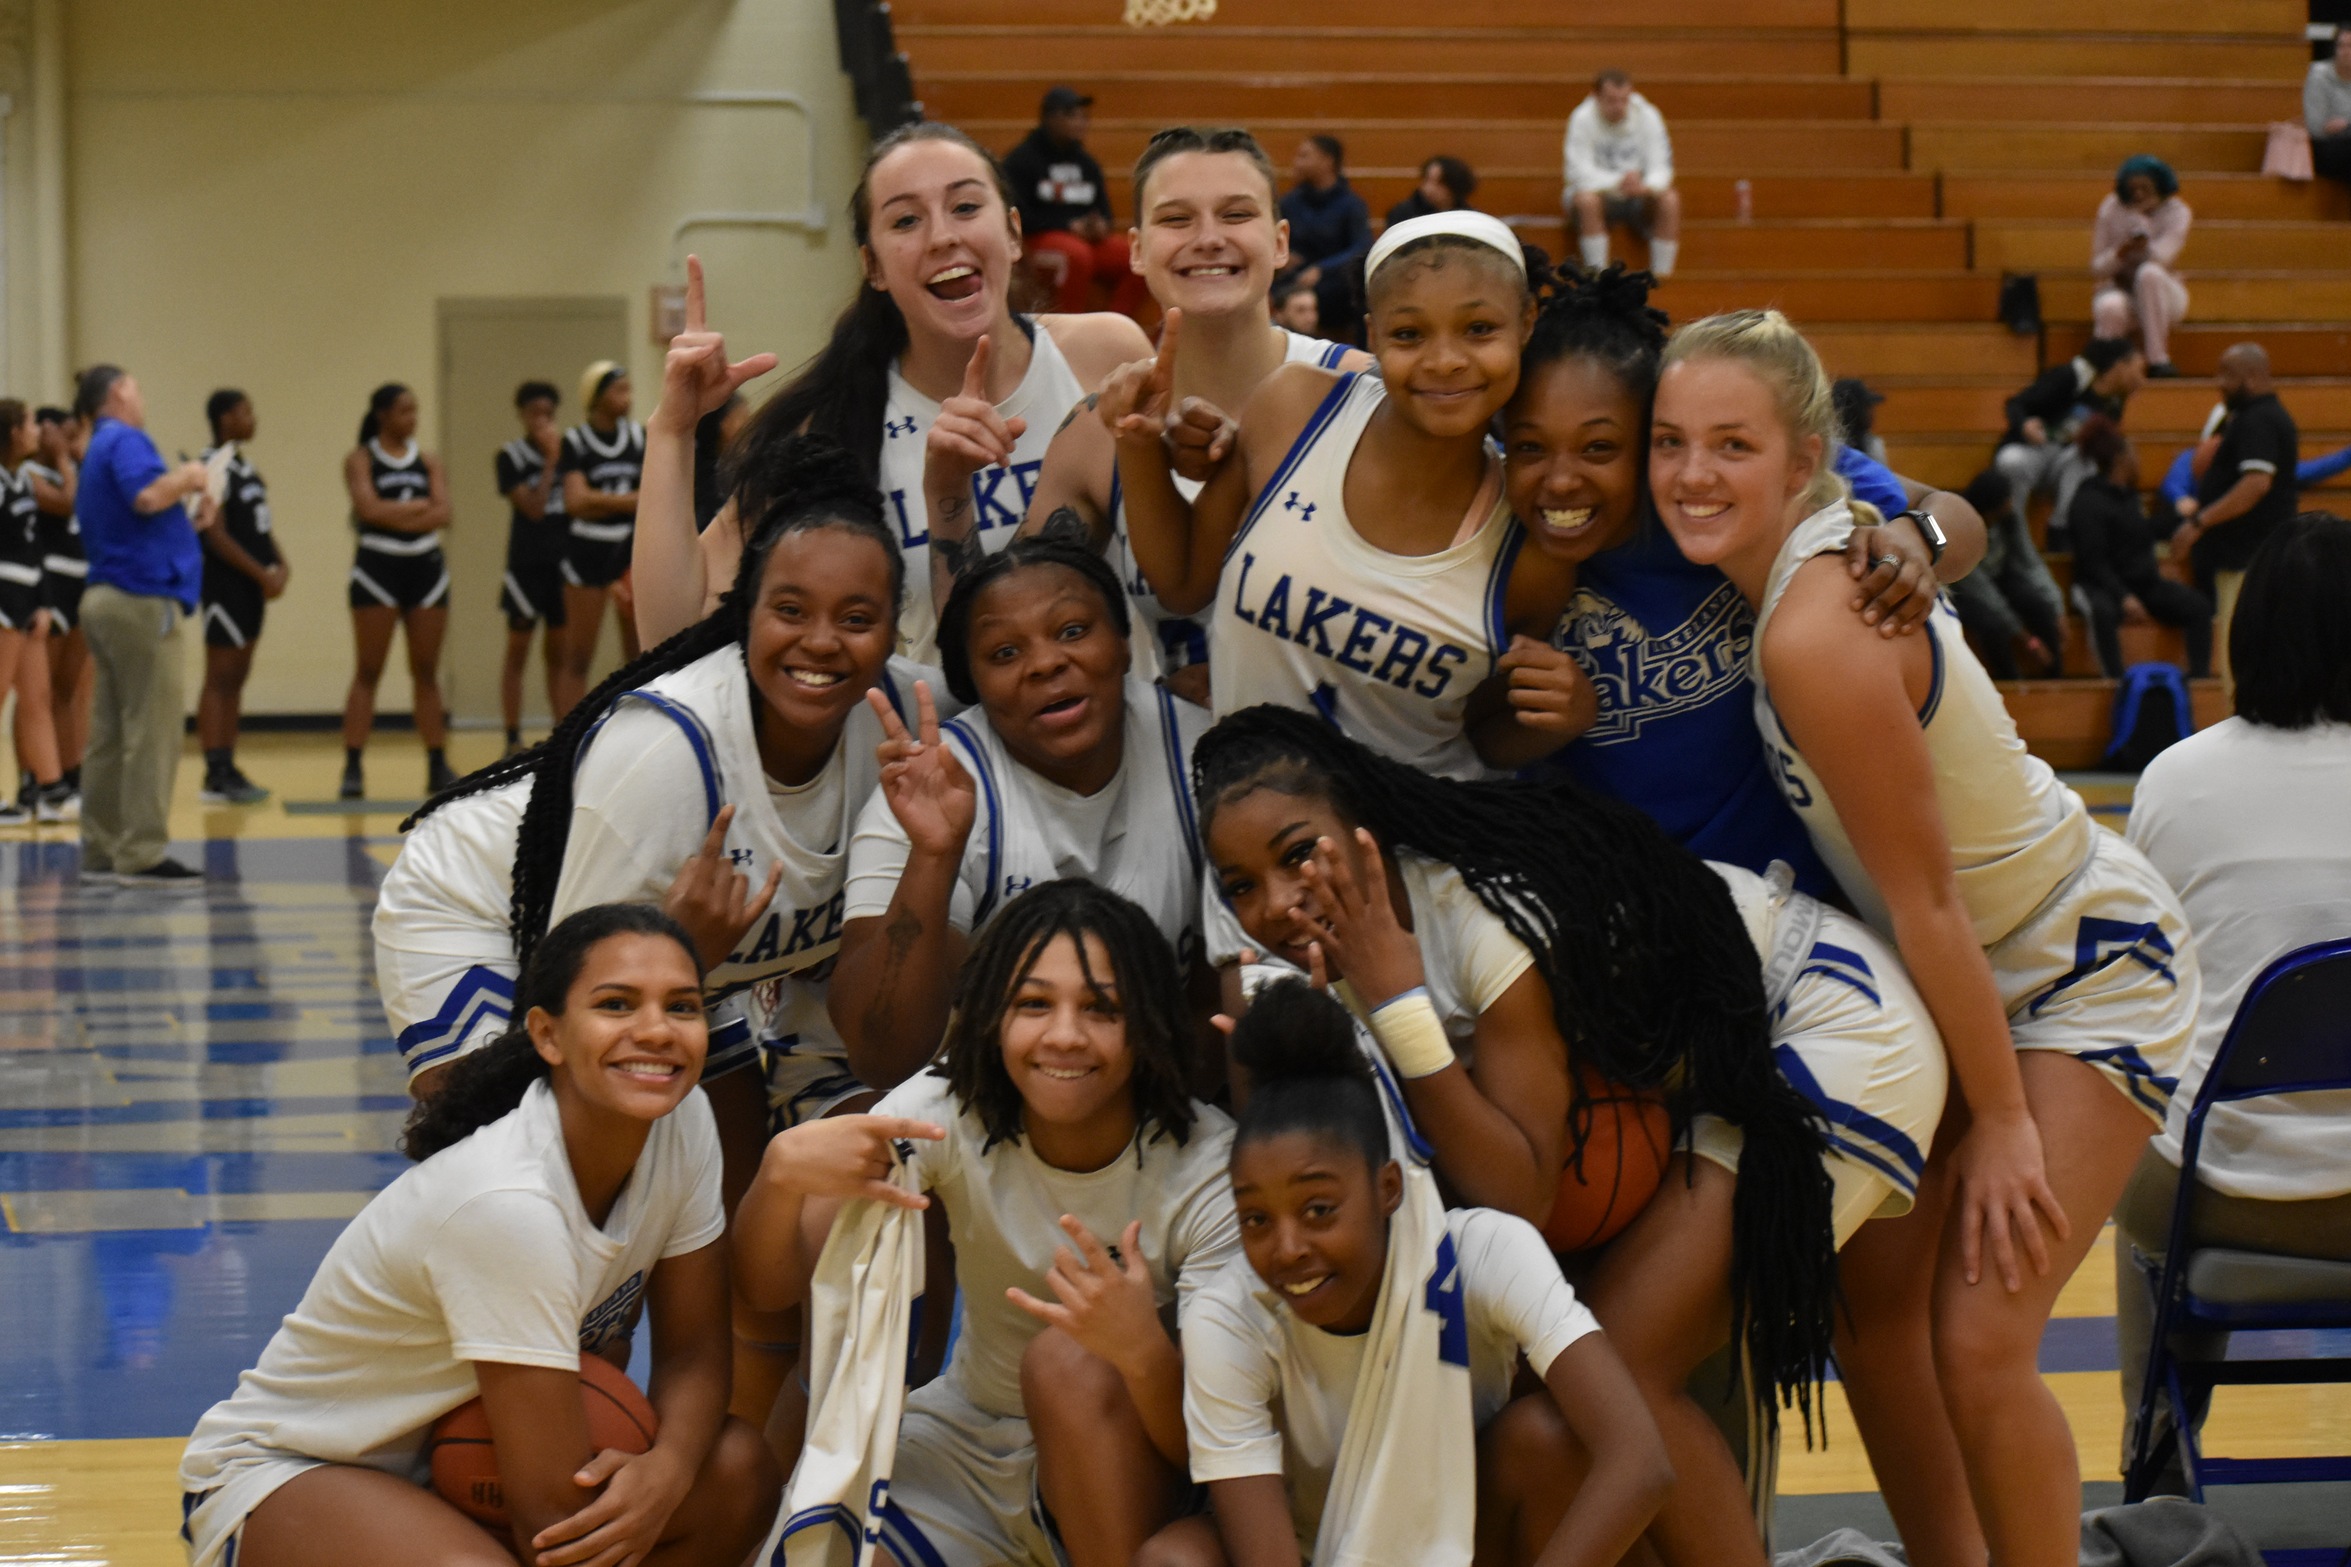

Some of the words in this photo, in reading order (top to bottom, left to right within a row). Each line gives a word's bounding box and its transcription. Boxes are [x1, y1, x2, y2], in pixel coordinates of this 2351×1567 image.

[890, 460, 1043, 549] LKE
[1235, 552, 1468, 699] LAKERS
[1583, 602, 1752, 716] akers
[727, 891, 844, 964] AKE
